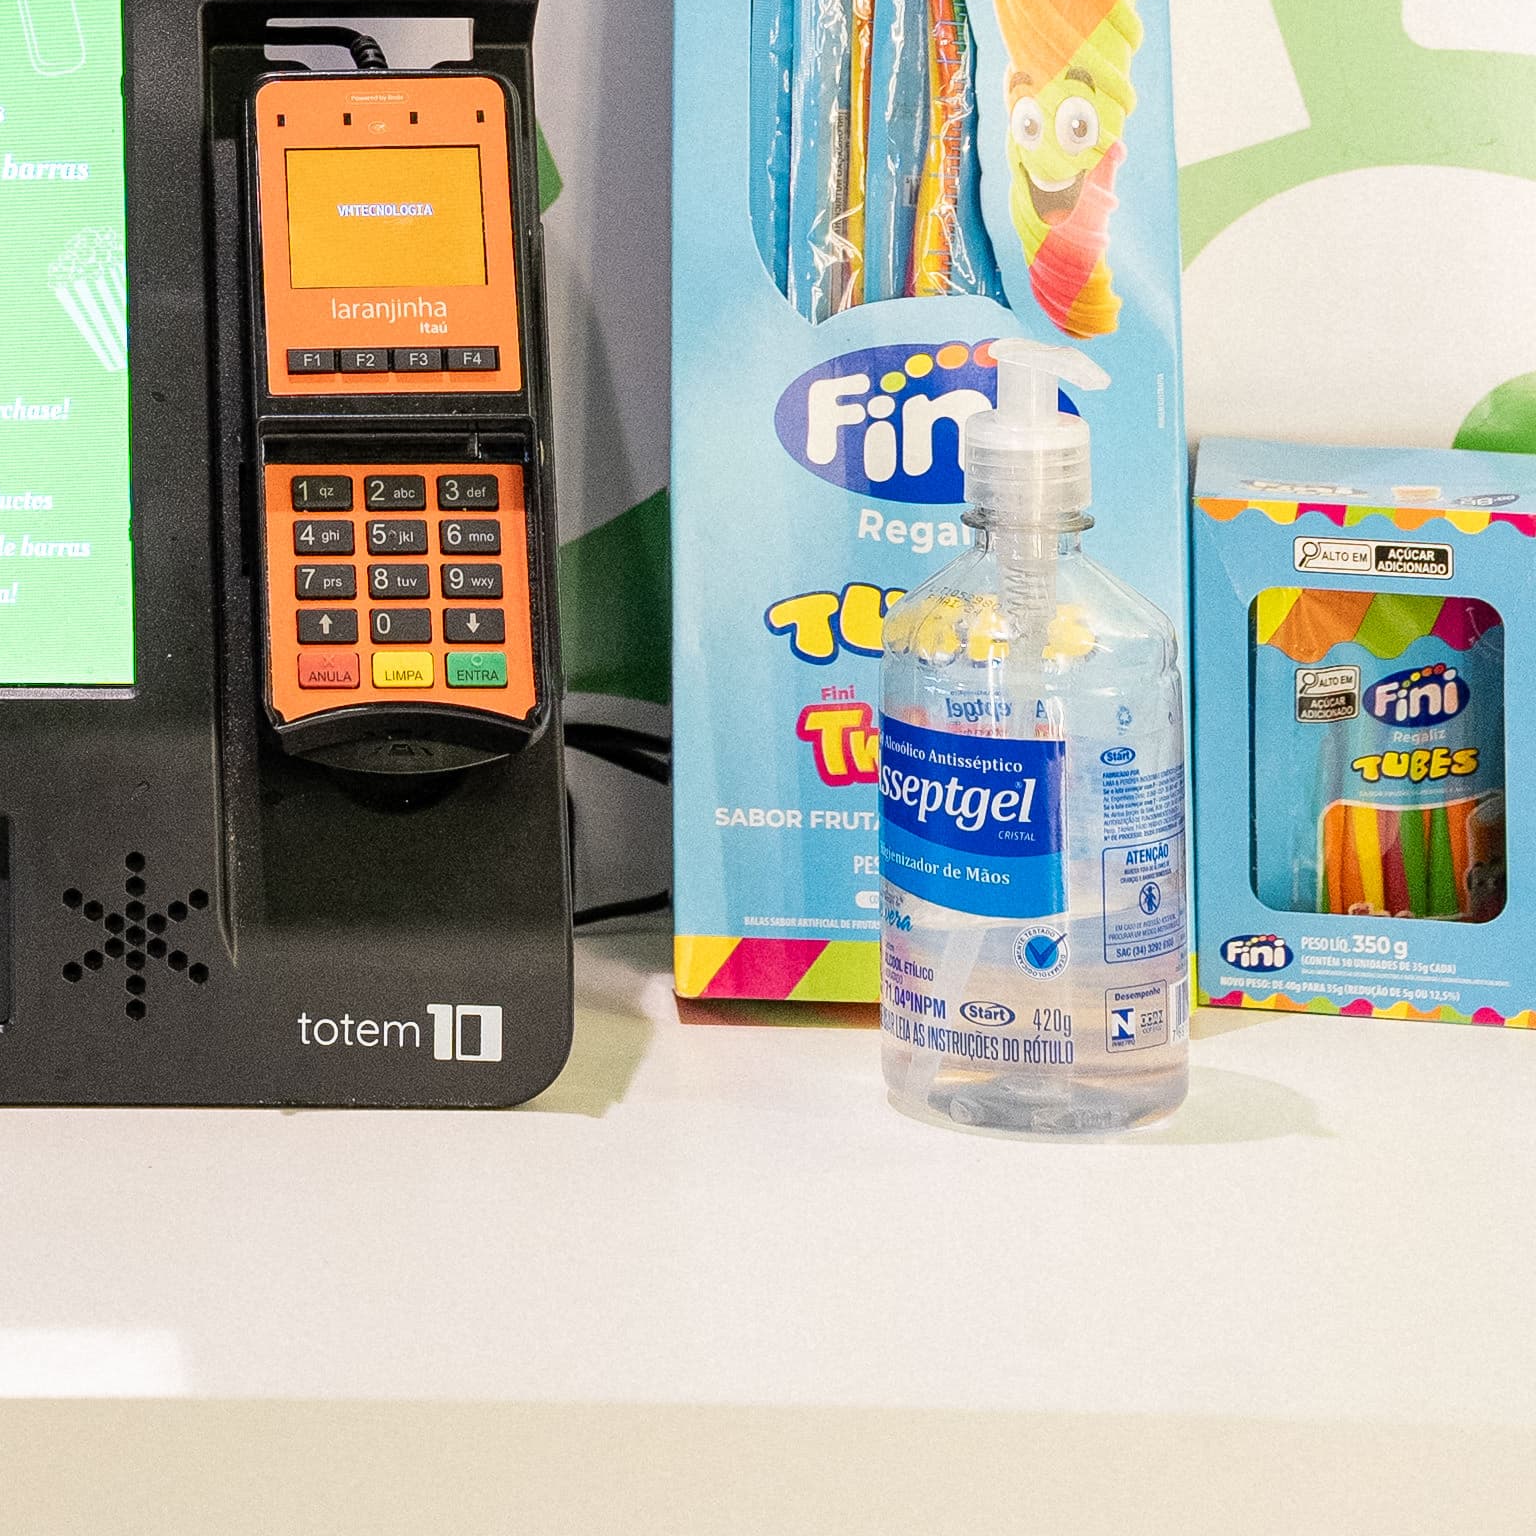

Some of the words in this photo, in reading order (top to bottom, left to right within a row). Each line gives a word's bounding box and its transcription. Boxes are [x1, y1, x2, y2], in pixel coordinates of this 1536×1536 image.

[2, 152, 90, 182] barras
[336, 203, 433, 218] VMTECNOLOGIA
[331, 297, 448, 325] laranjinha
[302, 351, 322, 367] F1
[355, 351, 375, 367] F2
[409, 351, 429, 367] F3
[462, 350, 483, 366] F4
[807, 373, 998, 482] Fin
[298, 481, 309, 501] 1
[370, 480, 386, 501] 2
[393, 487, 416, 499] abc
[445, 480, 460, 501] 3
[466, 486, 486, 498] def
[299, 525, 315, 545] 4
[321, 530, 340, 544] ghi
[372, 524, 387, 545] 5
[398, 531, 414, 544] jkl
[446, 524, 462, 545] 6
[468, 532, 495, 542] mno
[21, 533, 91, 558] barras
[1387, 546, 1435, 564] AÇÚCAR
[1322, 550, 1350, 563] ALTO
[1352, 552, 1369, 564] EM
[301, 569, 316, 589] 7
[323, 577, 343, 589] prs
[374, 568, 388, 589] 8
[396, 576, 418, 588] tuv
[449, 568, 464, 589] 9
[471, 577, 494, 589] wxy
[1376, 560, 1447, 576] ADICIONADO
[376, 613, 391, 634] 0
[308, 670, 353, 682] ANULA
[385, 670, 424, 682] LIMPA
[457, 669, 500, 681] ENTRA
[821, 684, 856, 701] Fini
[1373, 667, 1459, 723] Fini
[1300, 705, 1354, 720] ADICIONADO
[1393, 729, 1447, 745] Regaliz
[885, 735, 926, 761] Alcoólico
[929, 748, 1023, 774] Antisséptico
[1106, 750, 1131, 762] Start
[1351, 746, 1480, 783] TUBES
[714, 807, 803, 829] SABOR
[998, 830, 1036, 842] CRISTAL
[1125, 842, 1170, 866] ATENÇÃO
[943, 863, 961, 879] de
[966, 866, 1011, 885] Mãos
[770, 917, 796, 927] SABOR
[798, 918, 839, 929] ARTIFICIAL
[1116, 946, 1132, 958] SAC
[1227, 937, 1287, 968] Fini
[1300, 936, 1329, 952] PESO
[1352, 934, 1391, 955] 350
[1394, 939, 1409, 960] g
[904, 960, 934, 982] ETÍLICO
[1353, 957, 1398, 971] UNIDADES
[1114, 986, 1162, 1003] Desempenho
[1344, 982, 1391, 999] (REDUÇÃO
[968, 1004, 1006, 1022] Start
[1032, 1008, 1073, 1038] 420g
[298, 1011, 421, 1049] totem
[426, 1003, 504, 1062] 10
[896, 1015, 912, 1043] LEIA
[913, 1023, 926, 1048] AS
[927, 1026, 999, 1061] INSTRUÇÕES
[1002, 1037, 1020, 1063] DO
[1023, 1034, 1074, 1065] RÓTULO
